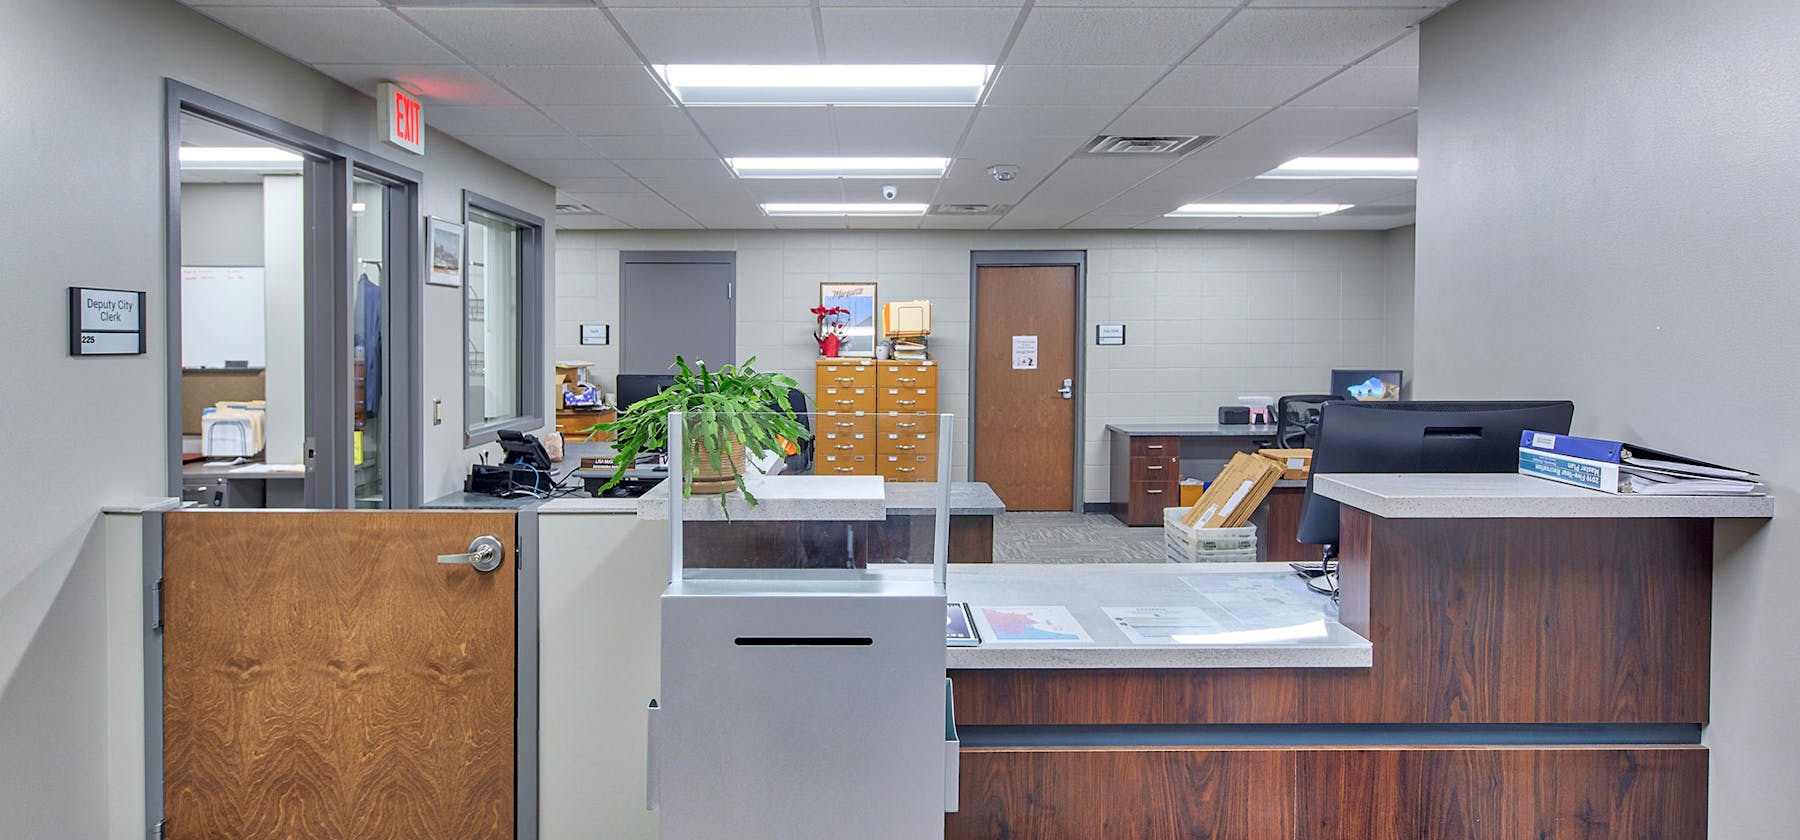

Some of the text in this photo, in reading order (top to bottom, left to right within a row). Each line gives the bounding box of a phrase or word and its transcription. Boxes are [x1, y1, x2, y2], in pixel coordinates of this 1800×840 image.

[395, 92, 420, 146] EXIT
[87, 298, 133, 312] Deputy City
[100, 311, 121, 321] Clerk
[1567, 462, 1600, 476] Master Plan
